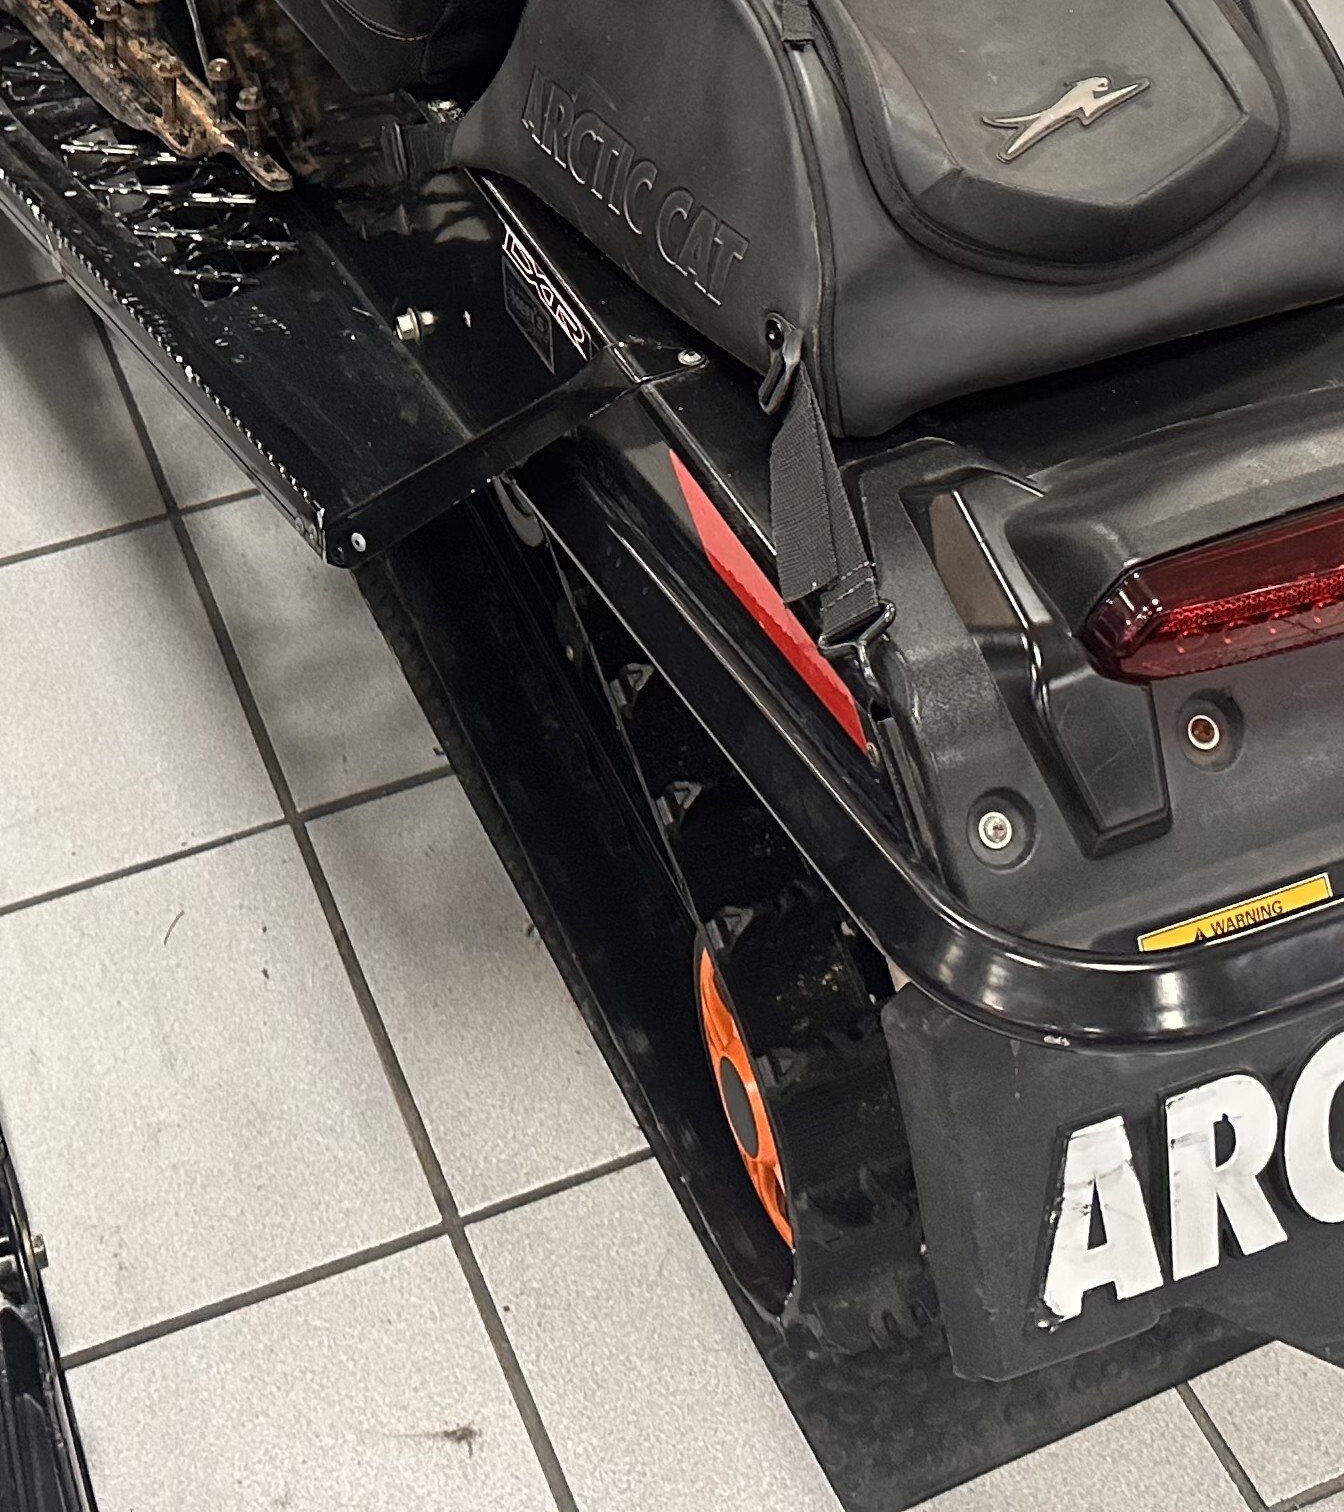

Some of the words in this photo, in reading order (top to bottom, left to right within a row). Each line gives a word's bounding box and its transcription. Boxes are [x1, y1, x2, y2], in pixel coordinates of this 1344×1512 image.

[520, 67, 658, 236] ARCTIC
[655, 186, 750, 307] CAT
[1210, 899, 1284, 936] WARNING
